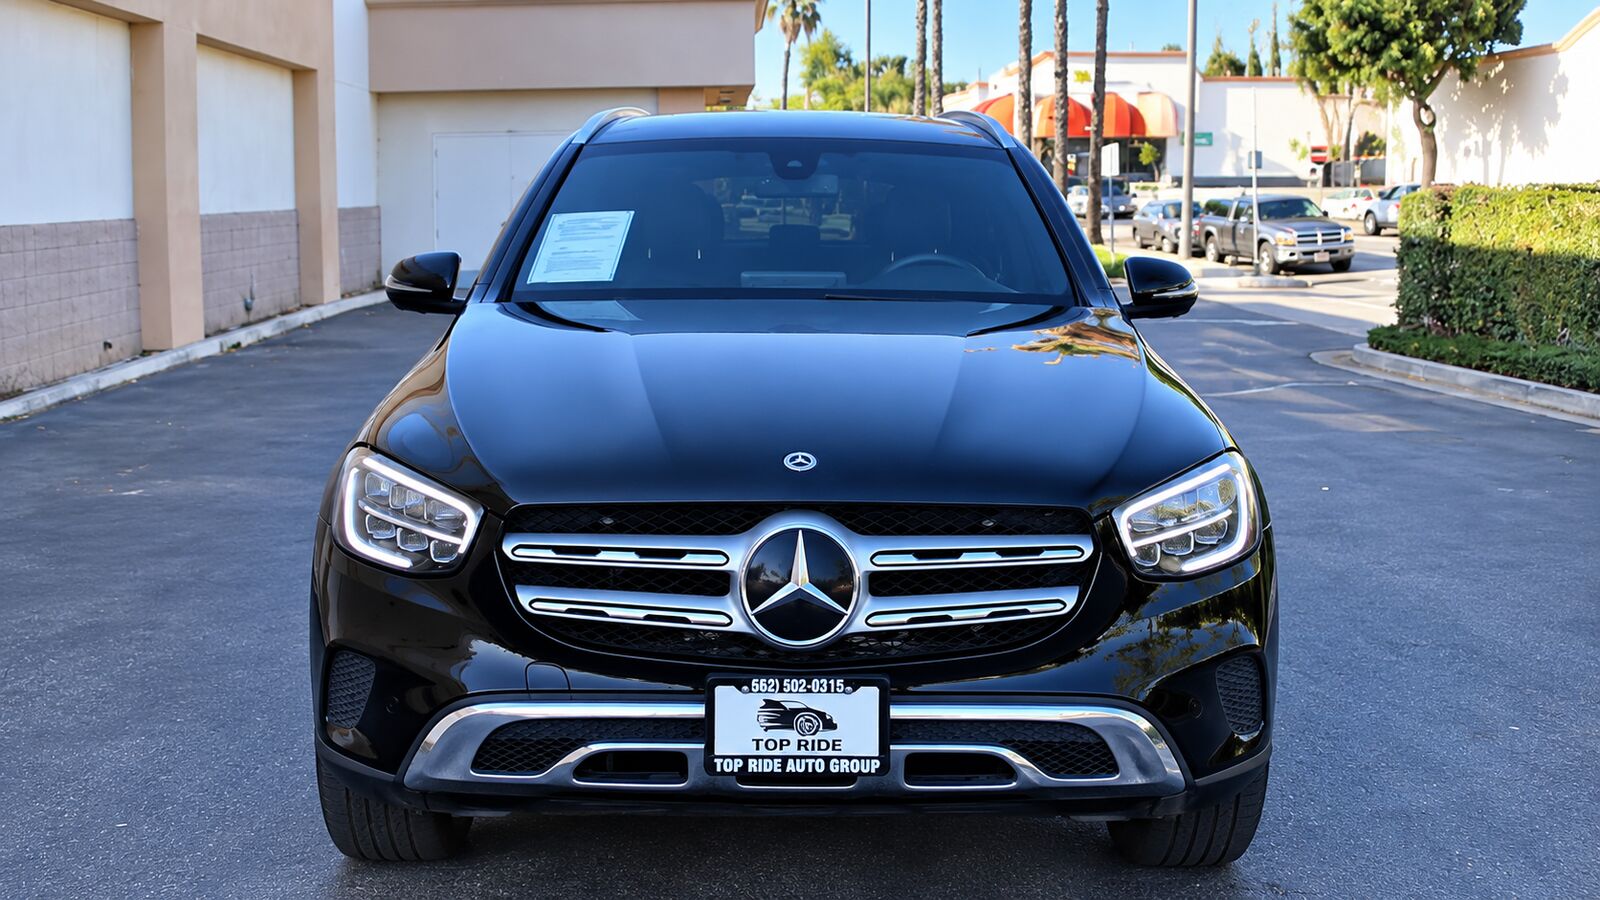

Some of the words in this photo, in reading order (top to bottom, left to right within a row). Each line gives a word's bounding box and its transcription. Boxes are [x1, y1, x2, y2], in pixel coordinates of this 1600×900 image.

[783, 678, 844, 693] 502-0315
[752, 738, 791, 751] TOP
[796, 739, 842, 751] RIDE
[714, 758, 743, 773] TOP
[748, 758, 782, 773] RIDE
[786, 758, 825, 773] AUTO
[829, 759, 881, 774] GROUP
